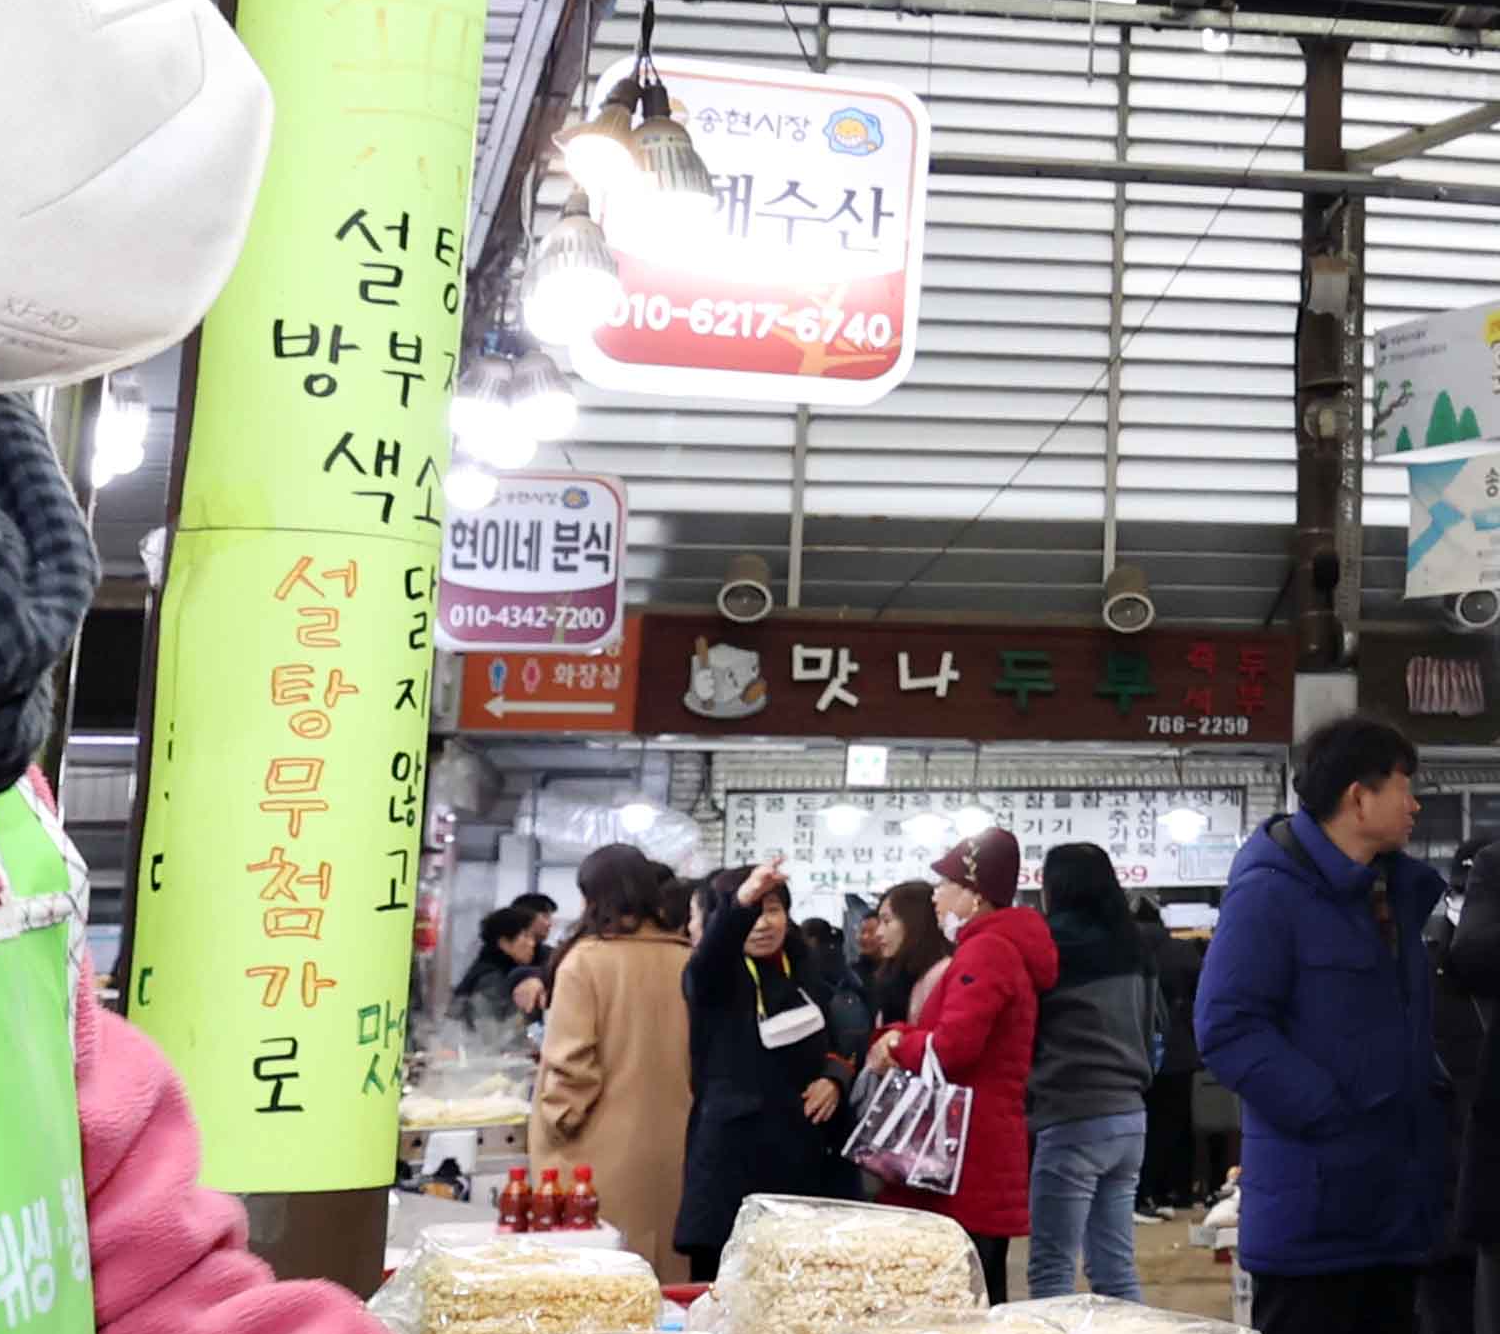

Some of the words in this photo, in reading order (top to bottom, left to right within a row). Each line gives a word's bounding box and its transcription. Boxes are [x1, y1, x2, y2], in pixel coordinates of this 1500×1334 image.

[695, 107, 812, 143] 송현시장
[602, 292, 894, 349] 010-6217-6740
[322, 431, 443, 528] 색소
[450, 518, 543, 572] 현이네
[553, 519, 612, 574] 분식
[449, 604, 606, 631] 010-4342-7200
[553, 662, 622, 689] 화장실
[1147, 715, 1250, 735] 766-2259
